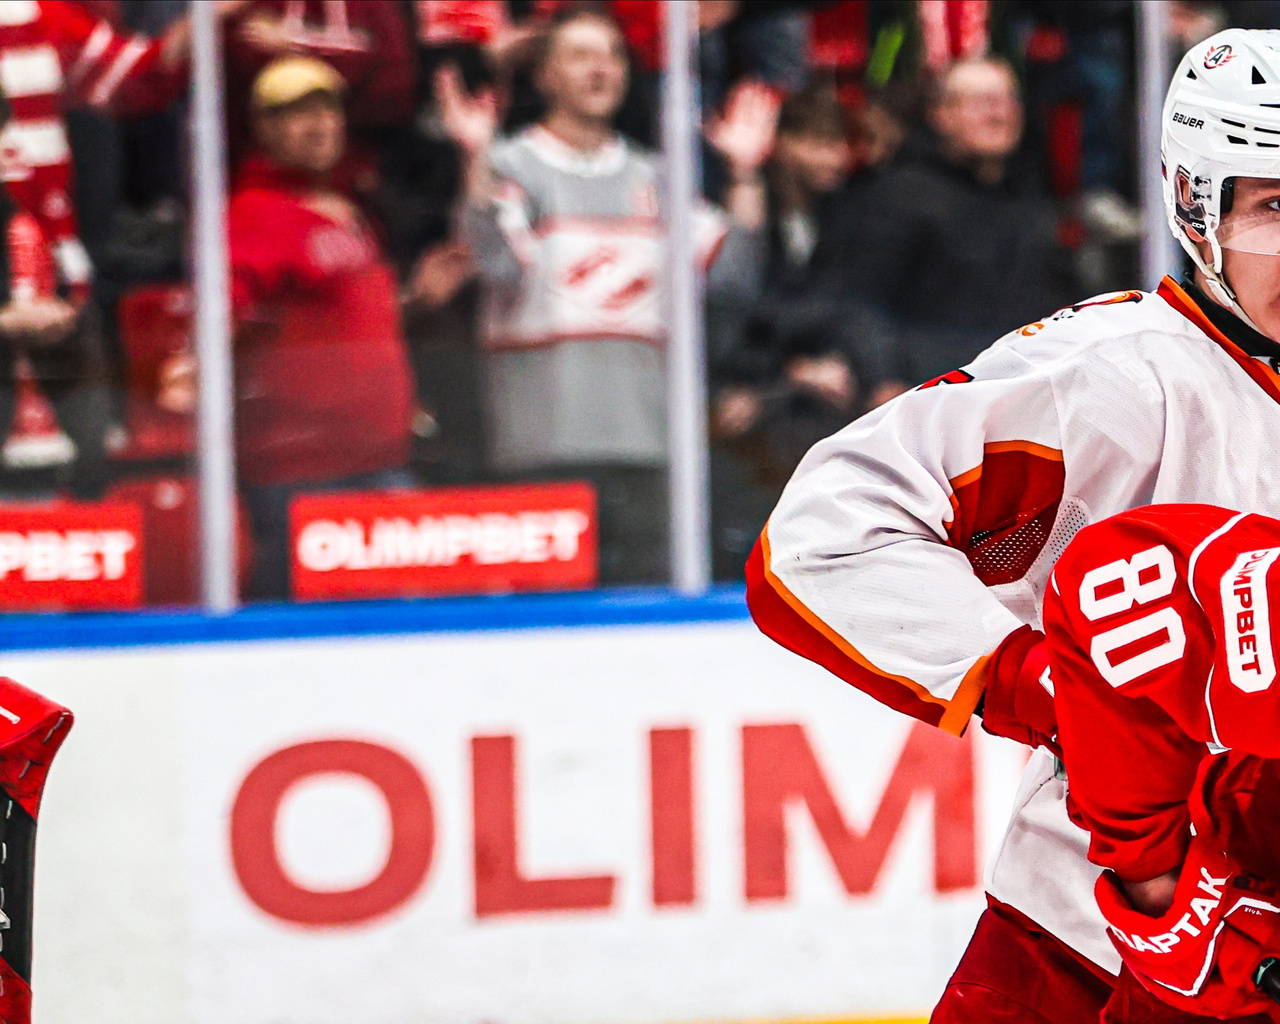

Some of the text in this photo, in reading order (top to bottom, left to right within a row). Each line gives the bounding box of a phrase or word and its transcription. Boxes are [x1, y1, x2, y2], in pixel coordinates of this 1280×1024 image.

[1172, 111, 1205, 130] BAUER
[298, 510, 588, 571] OLIMPBET
[1079, 544, 1187, 688] 80
[227, 723, 981, 928] OLIM
[1111, 867, 1228, 954] ПАРТАК
